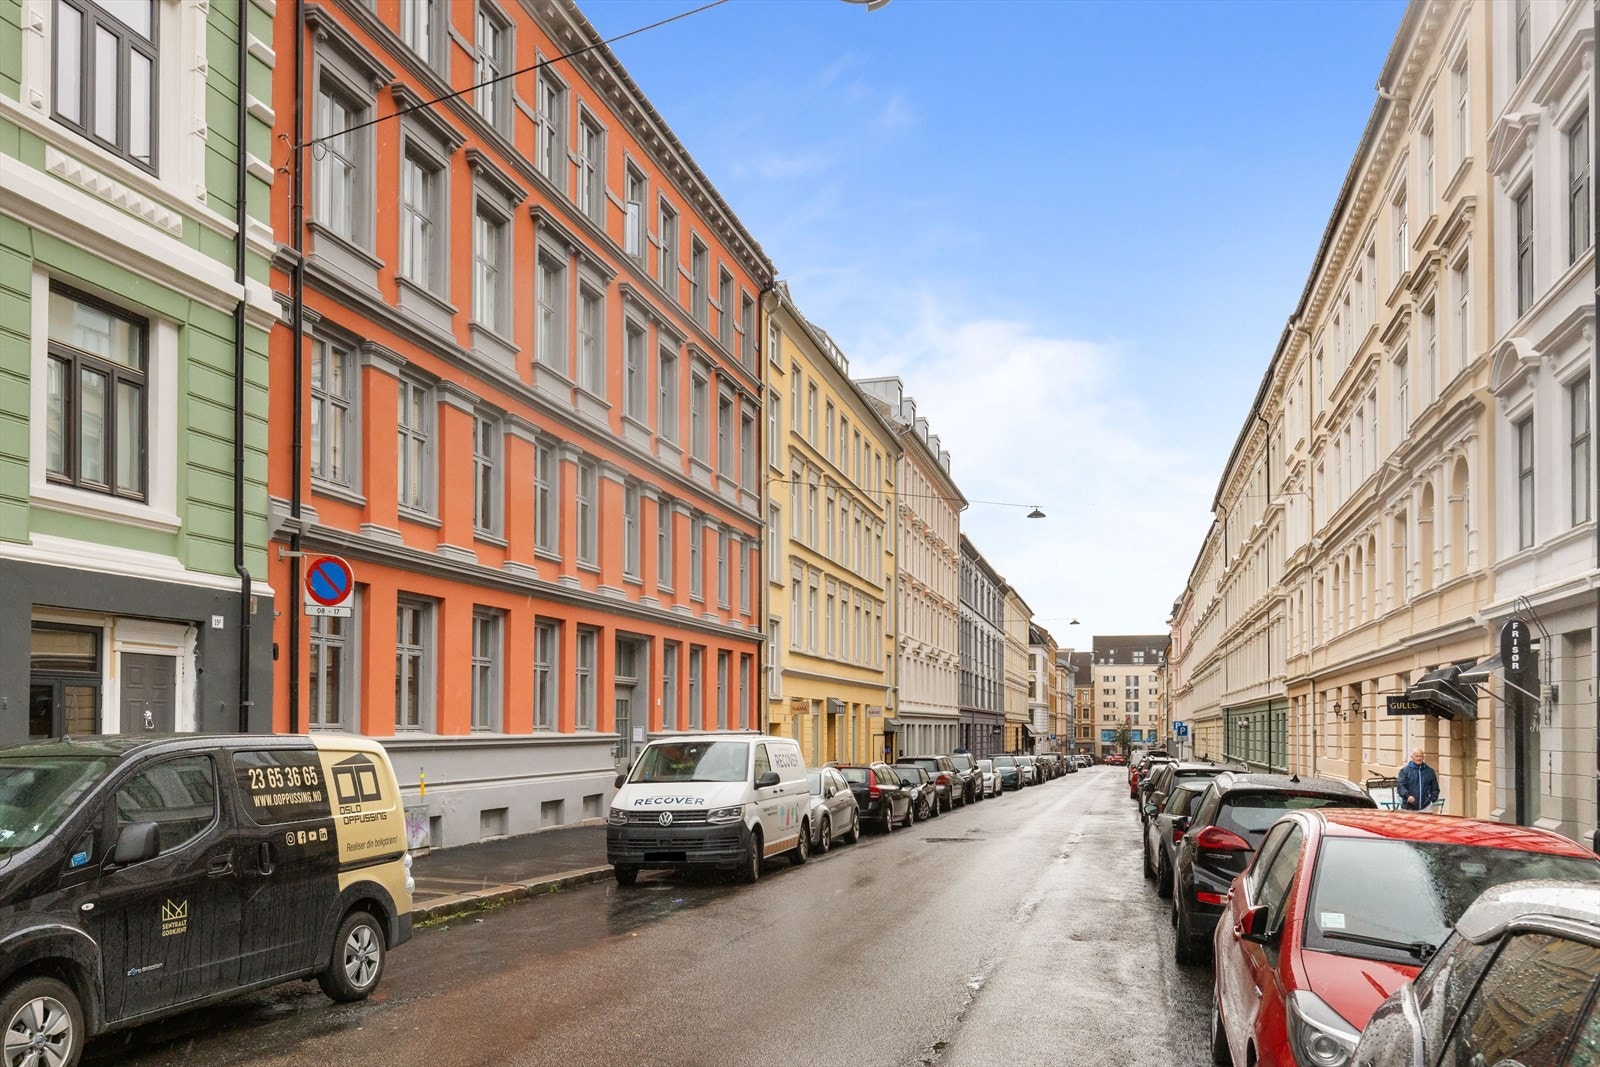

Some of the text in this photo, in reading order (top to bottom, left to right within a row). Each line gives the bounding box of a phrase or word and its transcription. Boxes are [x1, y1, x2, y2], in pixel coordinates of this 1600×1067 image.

[1511, 622, 1520, 670] FRISØR
[1389, 702, 1421, 710] GULLS
[1180, 726, 1186, 735] P
[774, 753, 799, 768] RECOVER
[248, 766, 318, 789] 23 65 36 65
[634, 797, 705, 806] RECOVER
[339, 804, 361, 815] OSLO
[343, 812, 387, 825] OPPUSSING
[162, 920, 187, 930] SENTRALT
